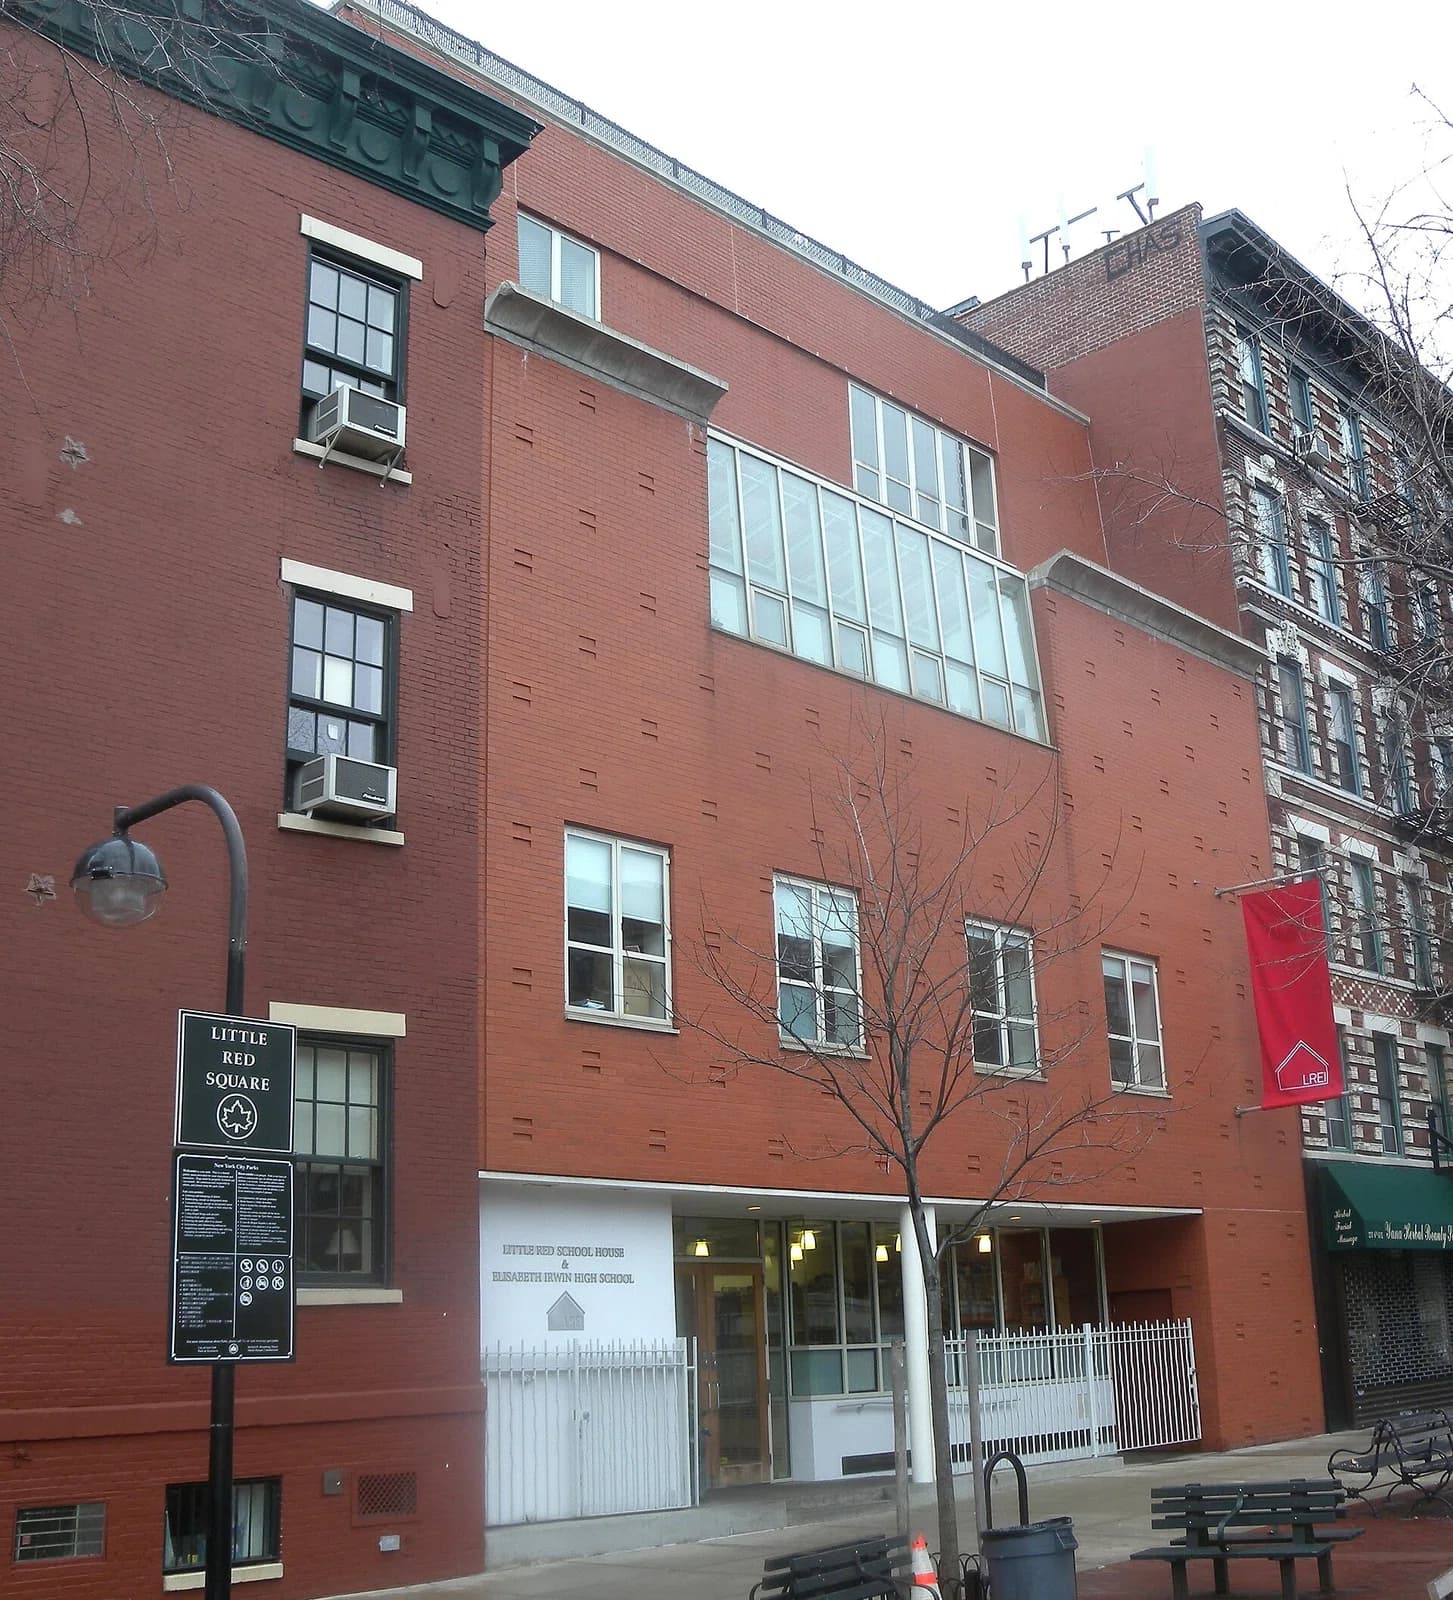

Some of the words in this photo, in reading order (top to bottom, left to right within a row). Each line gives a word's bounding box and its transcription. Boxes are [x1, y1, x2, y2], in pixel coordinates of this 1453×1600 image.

[211, 1026, 268, 1046] LITTLE
[222, 1050, 256, 1067] RED
[206, 1071, 270, 1091] SQUARE
[1302, 1071, 1327, 1086] LREI
[503, 1245, 534, 1256] LITTLE
[536, 1245, 555, 1256] RED
[556, 1246, 593, 1257] SCHOOL
[595, 1247, 625, 1258] HOUSE
[561, 1259, 569, 1269] &
[492, 1271, 542, 1283] ELISABETH
[544, 1272, 572, 1283] IRWIN
[574, 1272, 597, 1284] HIGH
[599, 1273, 635, 1284] SCHOOL
